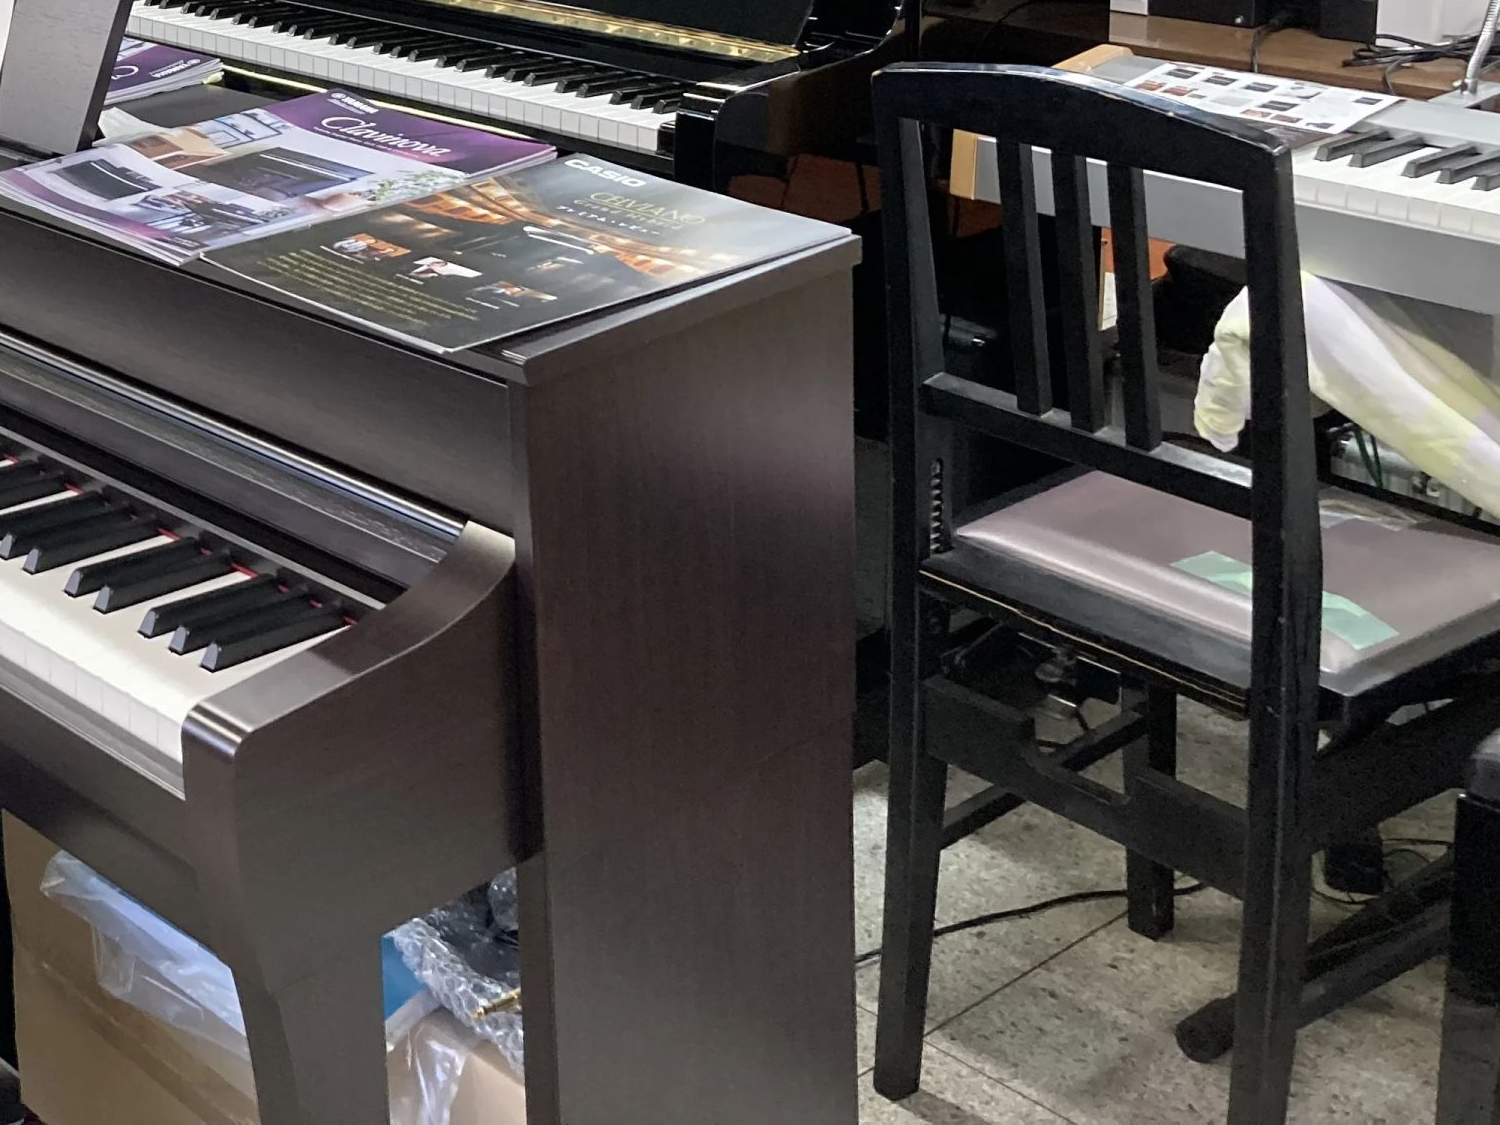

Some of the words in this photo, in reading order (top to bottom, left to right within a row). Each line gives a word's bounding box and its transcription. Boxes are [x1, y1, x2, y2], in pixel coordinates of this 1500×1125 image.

[320, 116, 452, 158] Clavinova
[564, 159, 647, 188] CASIO
[590, 192, 706, 225] CELVIANO
